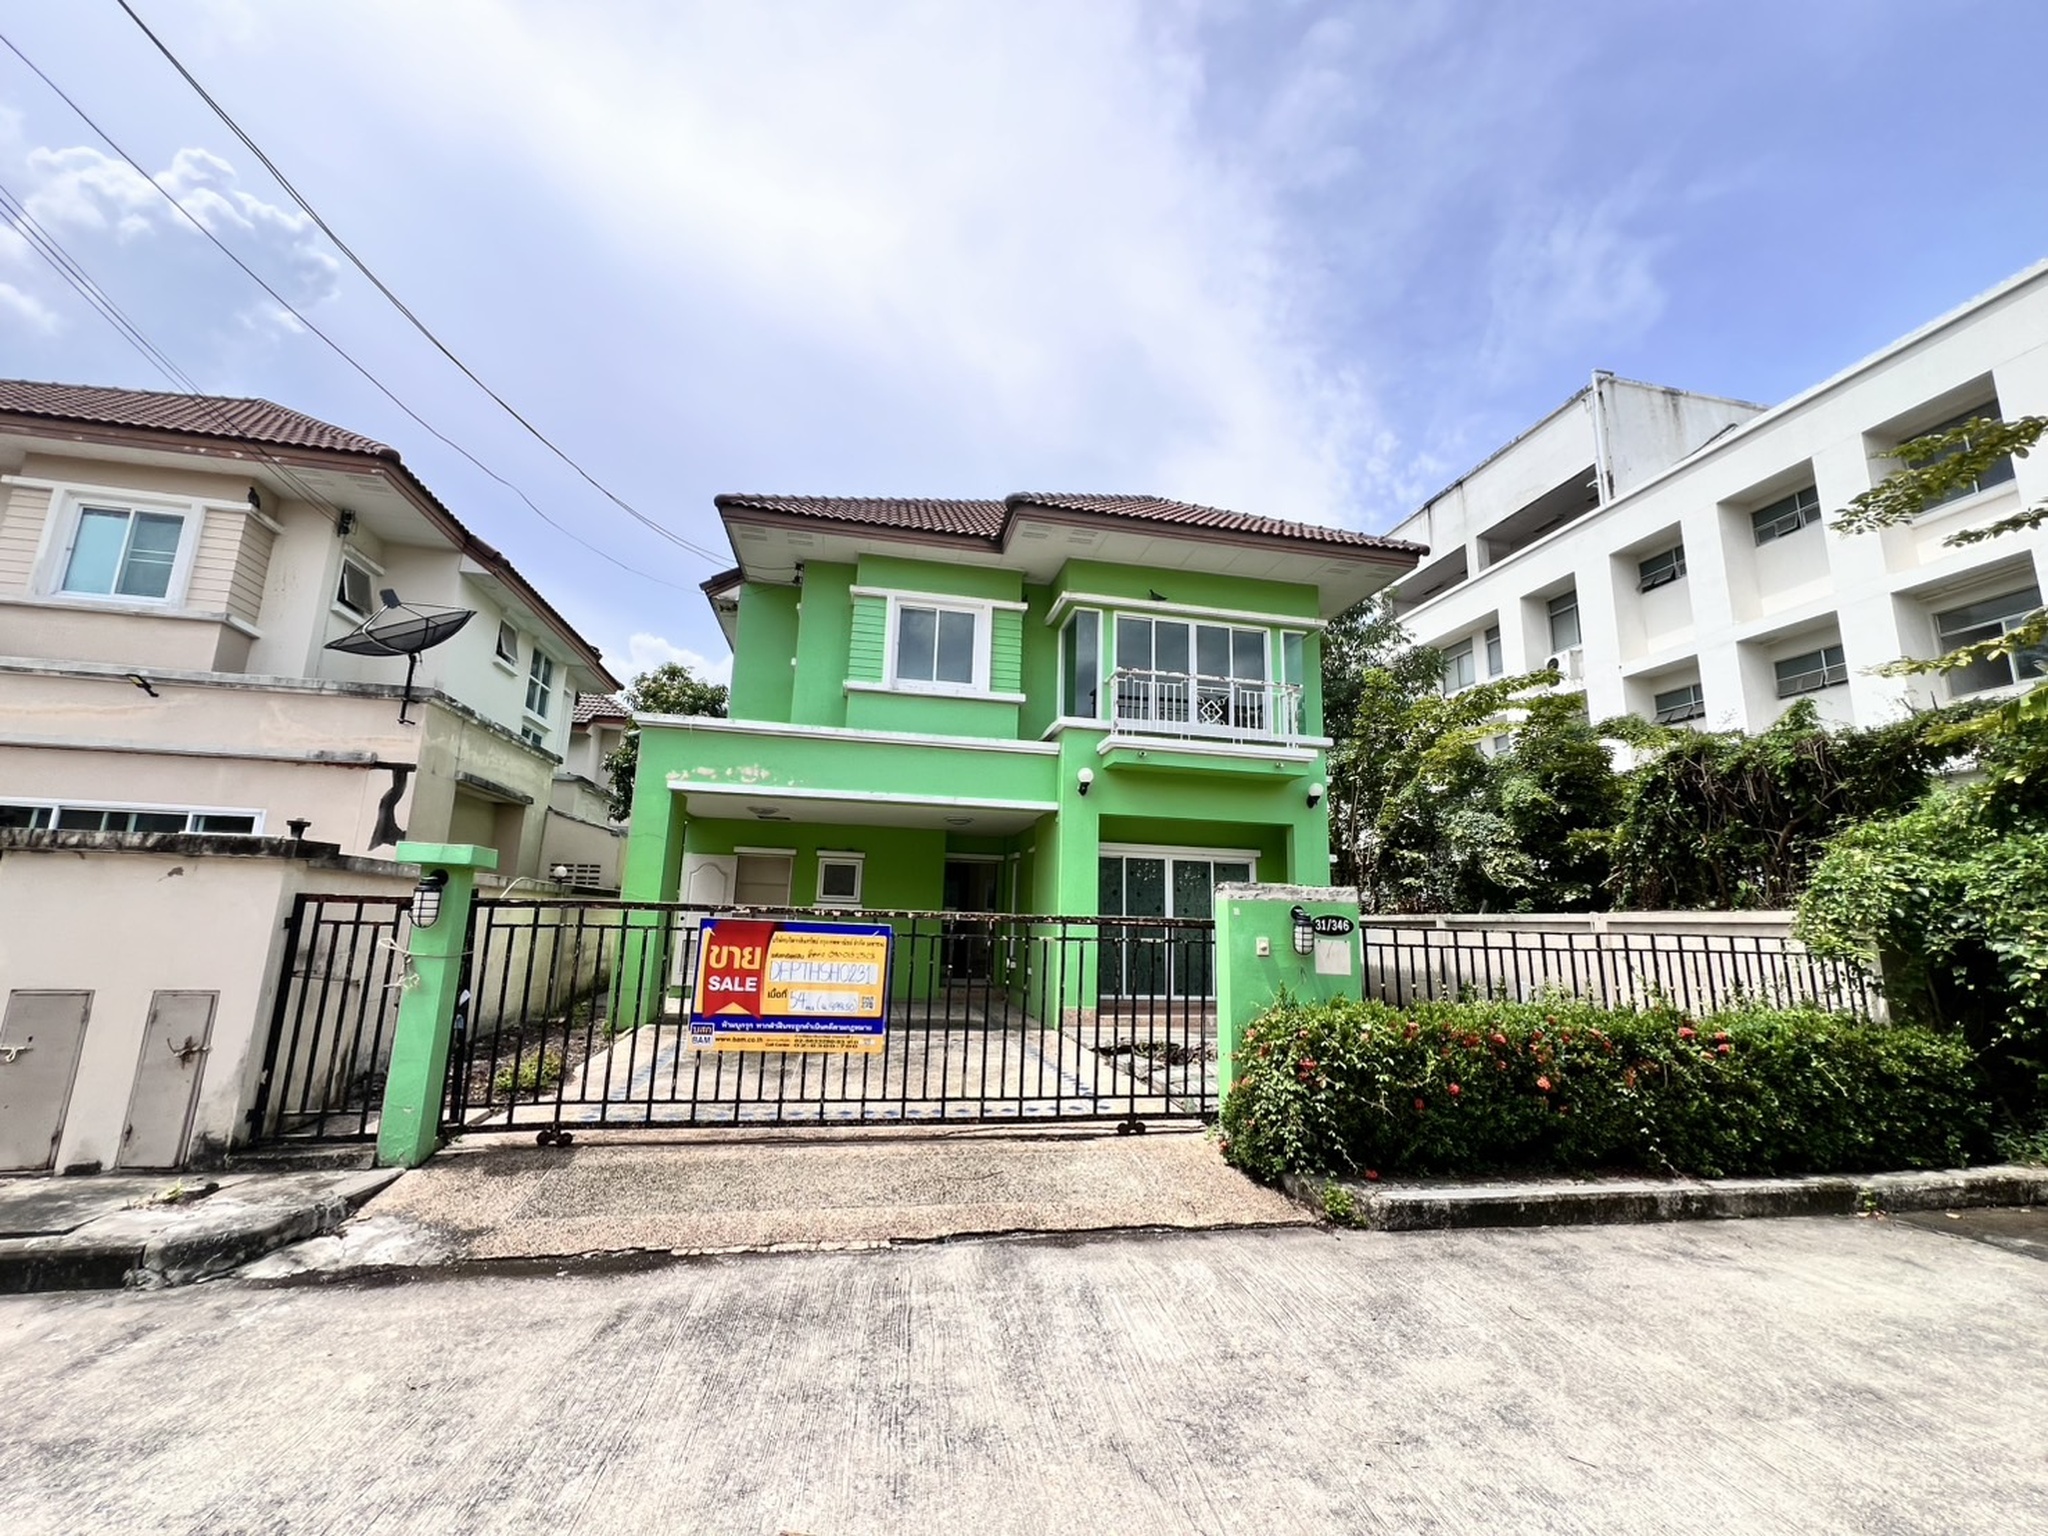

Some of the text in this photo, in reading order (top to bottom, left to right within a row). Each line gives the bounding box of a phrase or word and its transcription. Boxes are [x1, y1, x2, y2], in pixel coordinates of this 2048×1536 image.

[1315, 919, 1350, 932] 31/346
[709, 945, 762, 970] ขาย
[707, 975, 758, 992] SALE
[692, 1036, 711, 1044] BAM
